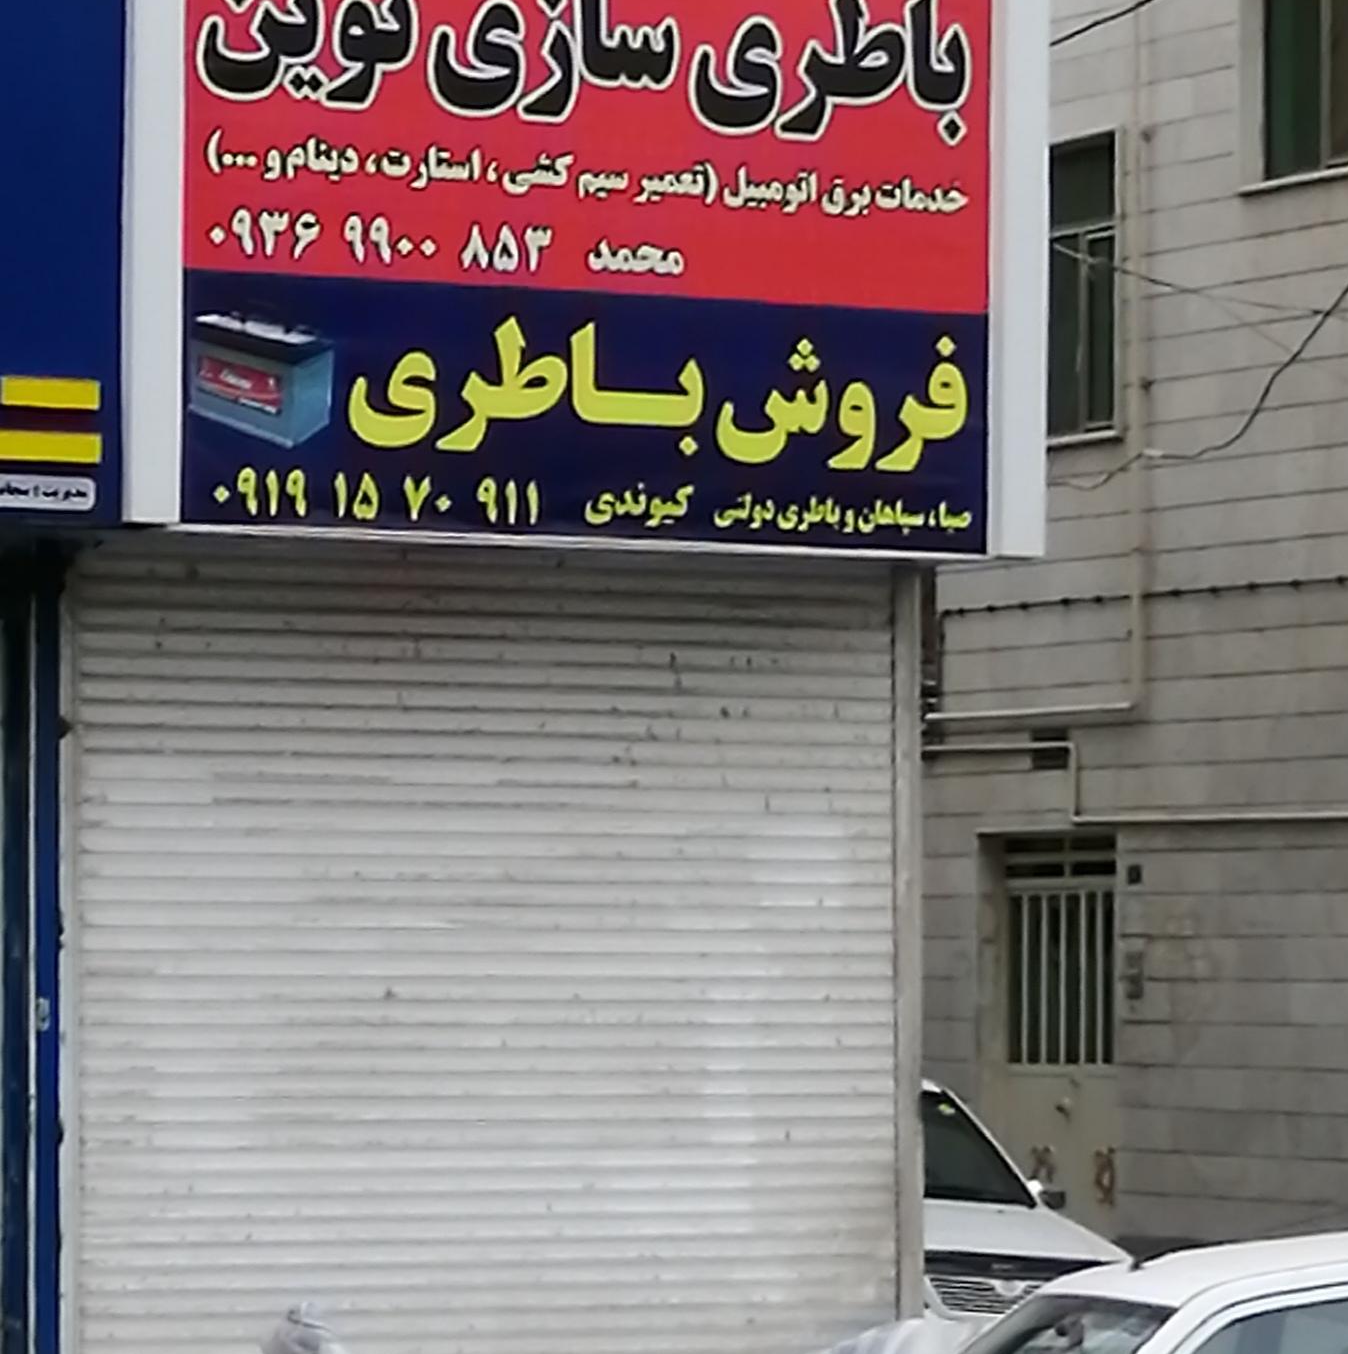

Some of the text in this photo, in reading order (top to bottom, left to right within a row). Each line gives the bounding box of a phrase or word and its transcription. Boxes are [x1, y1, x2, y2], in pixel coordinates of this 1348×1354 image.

[578, 168, 629, 199] سیم
[634, 162, 719, 205] (تعمیر
[723, 165, 818, 214] اتومبیل
[822, 177, 872, 217] برق
[876, 176, 968, 213] خدمات
[208, 208, 685, 276] محمد ۰۹۳۶ ۹۹۰۰ ۸۵۳
[348, 315, 968, 472] فروش باطری
[213, 466, 307, 517] ۰۹۱۹
[334, 471, 379, 520] ۱۵
[403, 475, 452, 521] ۷۰
[476, 476, 539, 525] ۹۱۱
[713, 492, 774, 529] دولتی
